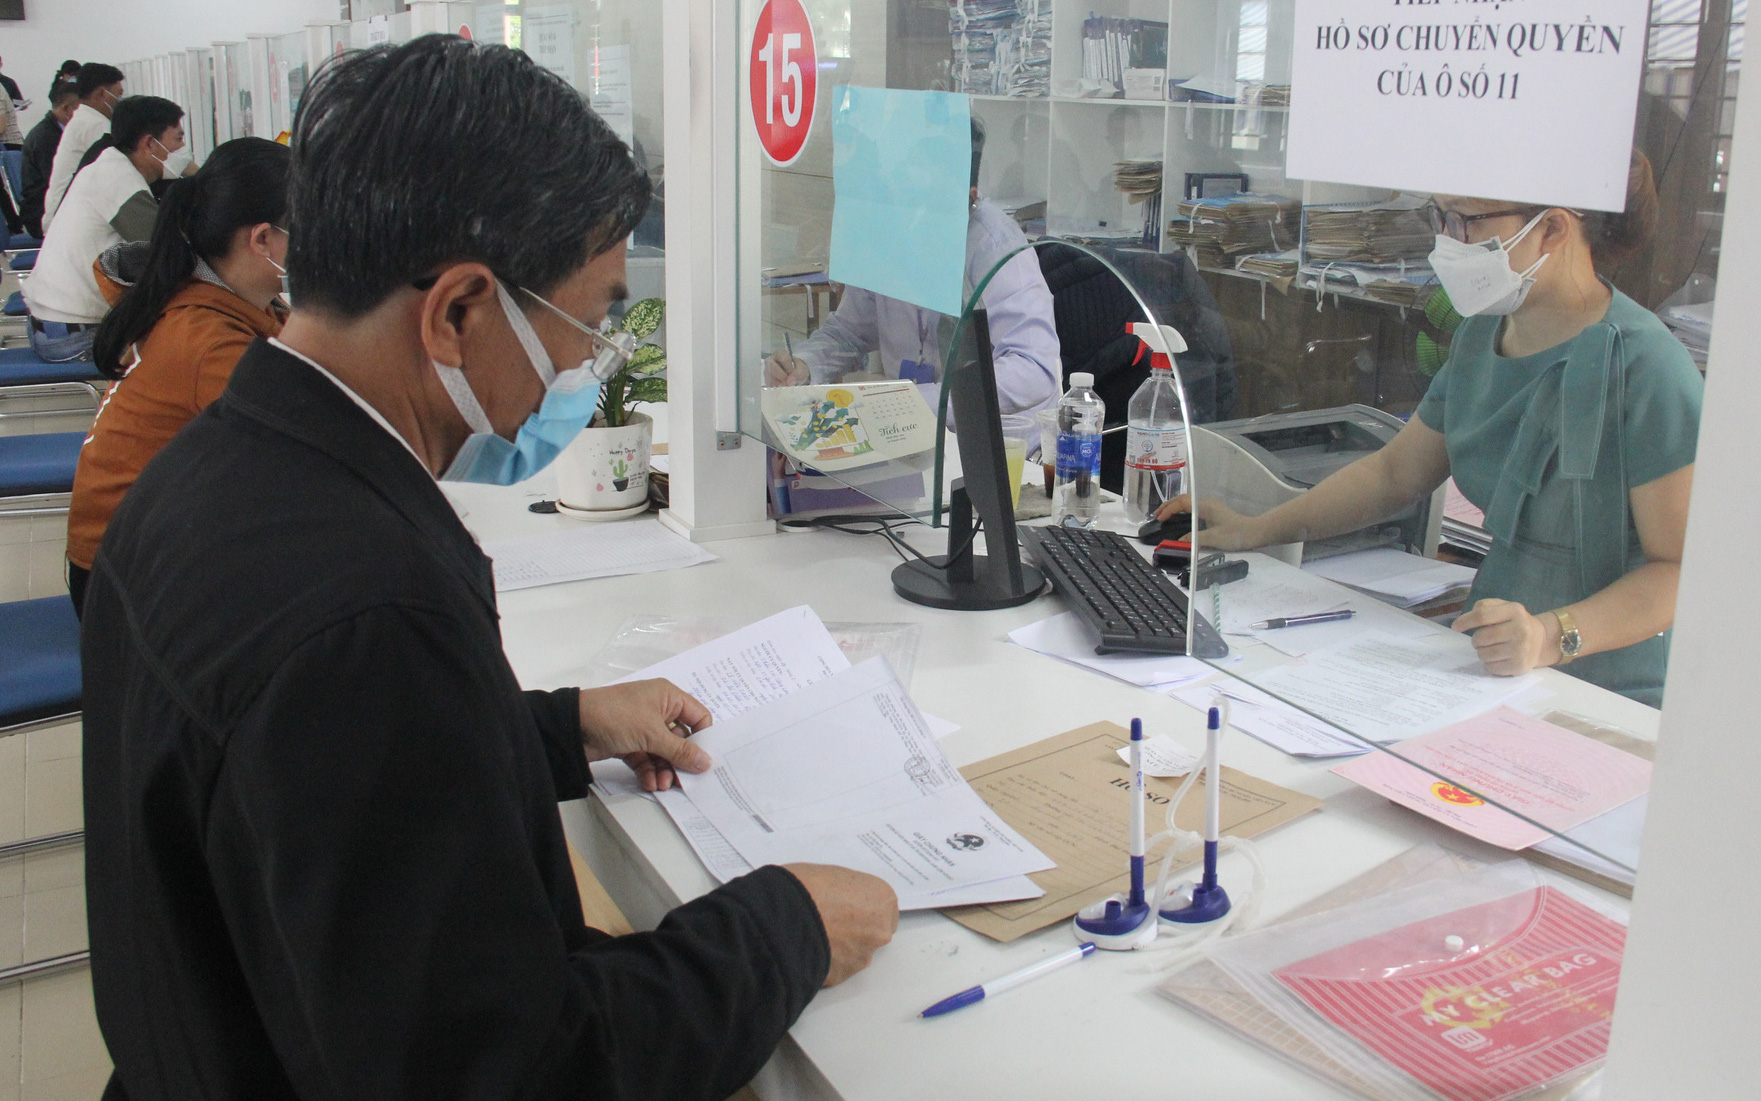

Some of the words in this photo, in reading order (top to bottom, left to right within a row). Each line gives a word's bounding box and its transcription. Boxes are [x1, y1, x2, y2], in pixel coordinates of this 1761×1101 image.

[1316, 17, 1350, 50] HỒ
[1356, 23, 1391, 50] SƠ
[1395, 16, 1501, 51] CHUYỂN
[1506, 15, 1626, 57] QUYỀN
[758, 33, 803, 127] 15
[1377, 63, 1428, 96] CỦA
[1435, 63, 1452, 97] Ô
[1458, 63, 1489, 98] SỐ
[1497, 72, 1521, 99] 11
[1420, 1004, 1460, 1027] MY
[1464, 973, 1544, 1007] CLEAR
[1543, 953, 1597, 978] BAG
